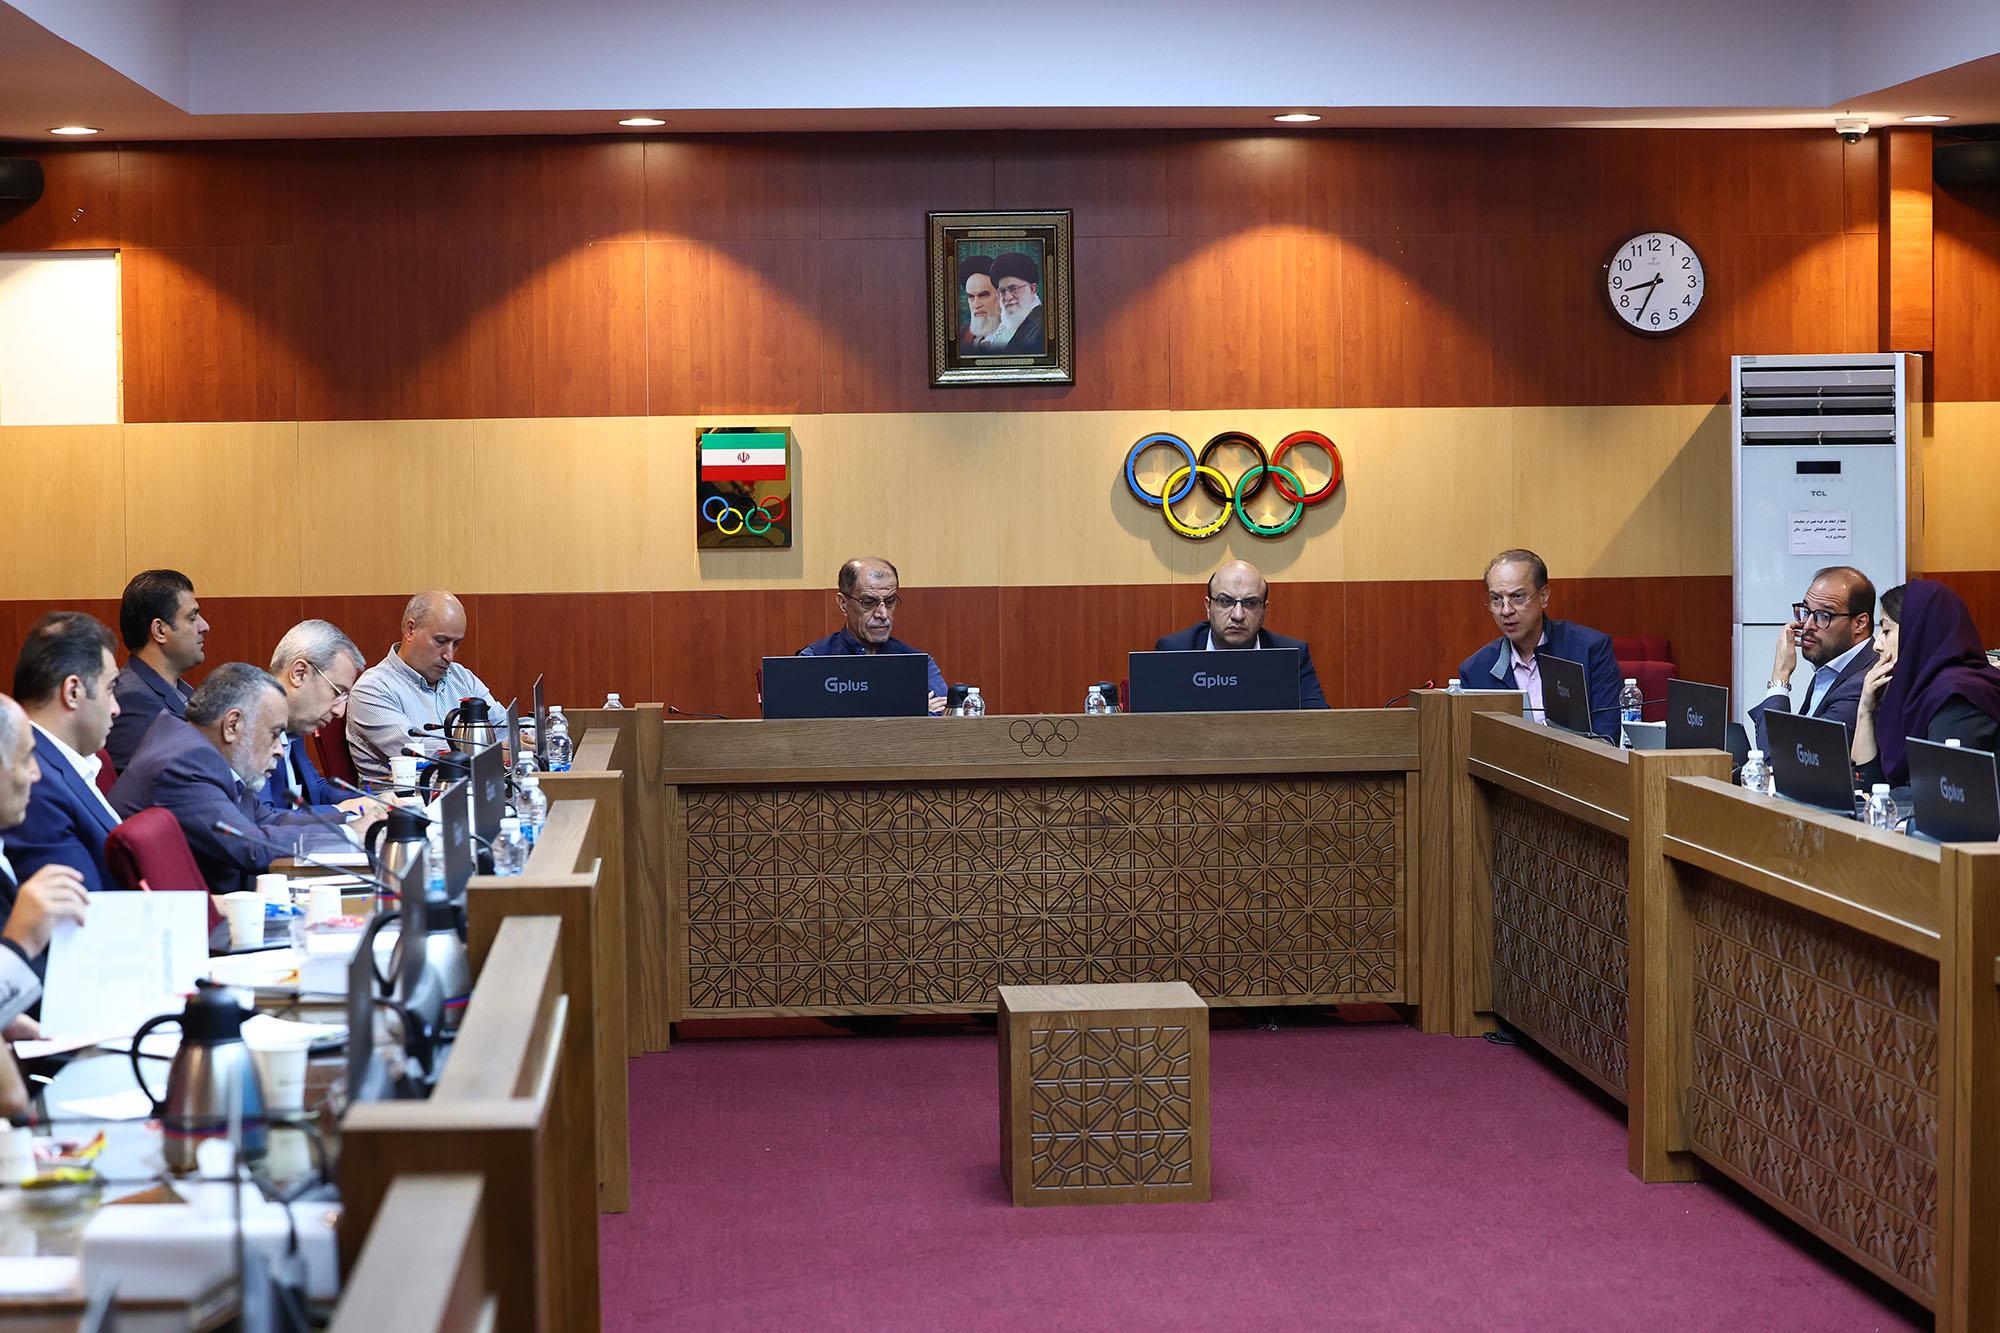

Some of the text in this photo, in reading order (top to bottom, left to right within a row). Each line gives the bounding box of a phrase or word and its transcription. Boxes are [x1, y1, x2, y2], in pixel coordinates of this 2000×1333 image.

[1630, 245, 1642, 257] 11
[1647, 239, 1661, 252] 12
[1670, 244, 1675, 256] 1
[1618, 259, 1632, 271] 10
[1682, 257, 1691, 269] 2
[1613, 276, 1622, 289] 9
[1688, 275, 1697, 288] 3
[1620, 295, 1630, 307] 8
[1682, 294, 1692, 306] 4
[1651, 312, 1660, 325] 6
[1669, 308, 1678, 320] 5
[824, 676, 869, 694] Gplus
[1192, 671, 1238, 689] Gplus
[1796, 743, 1820, 767] Gplus
[1940, 776, 1965, 804] Gplus
